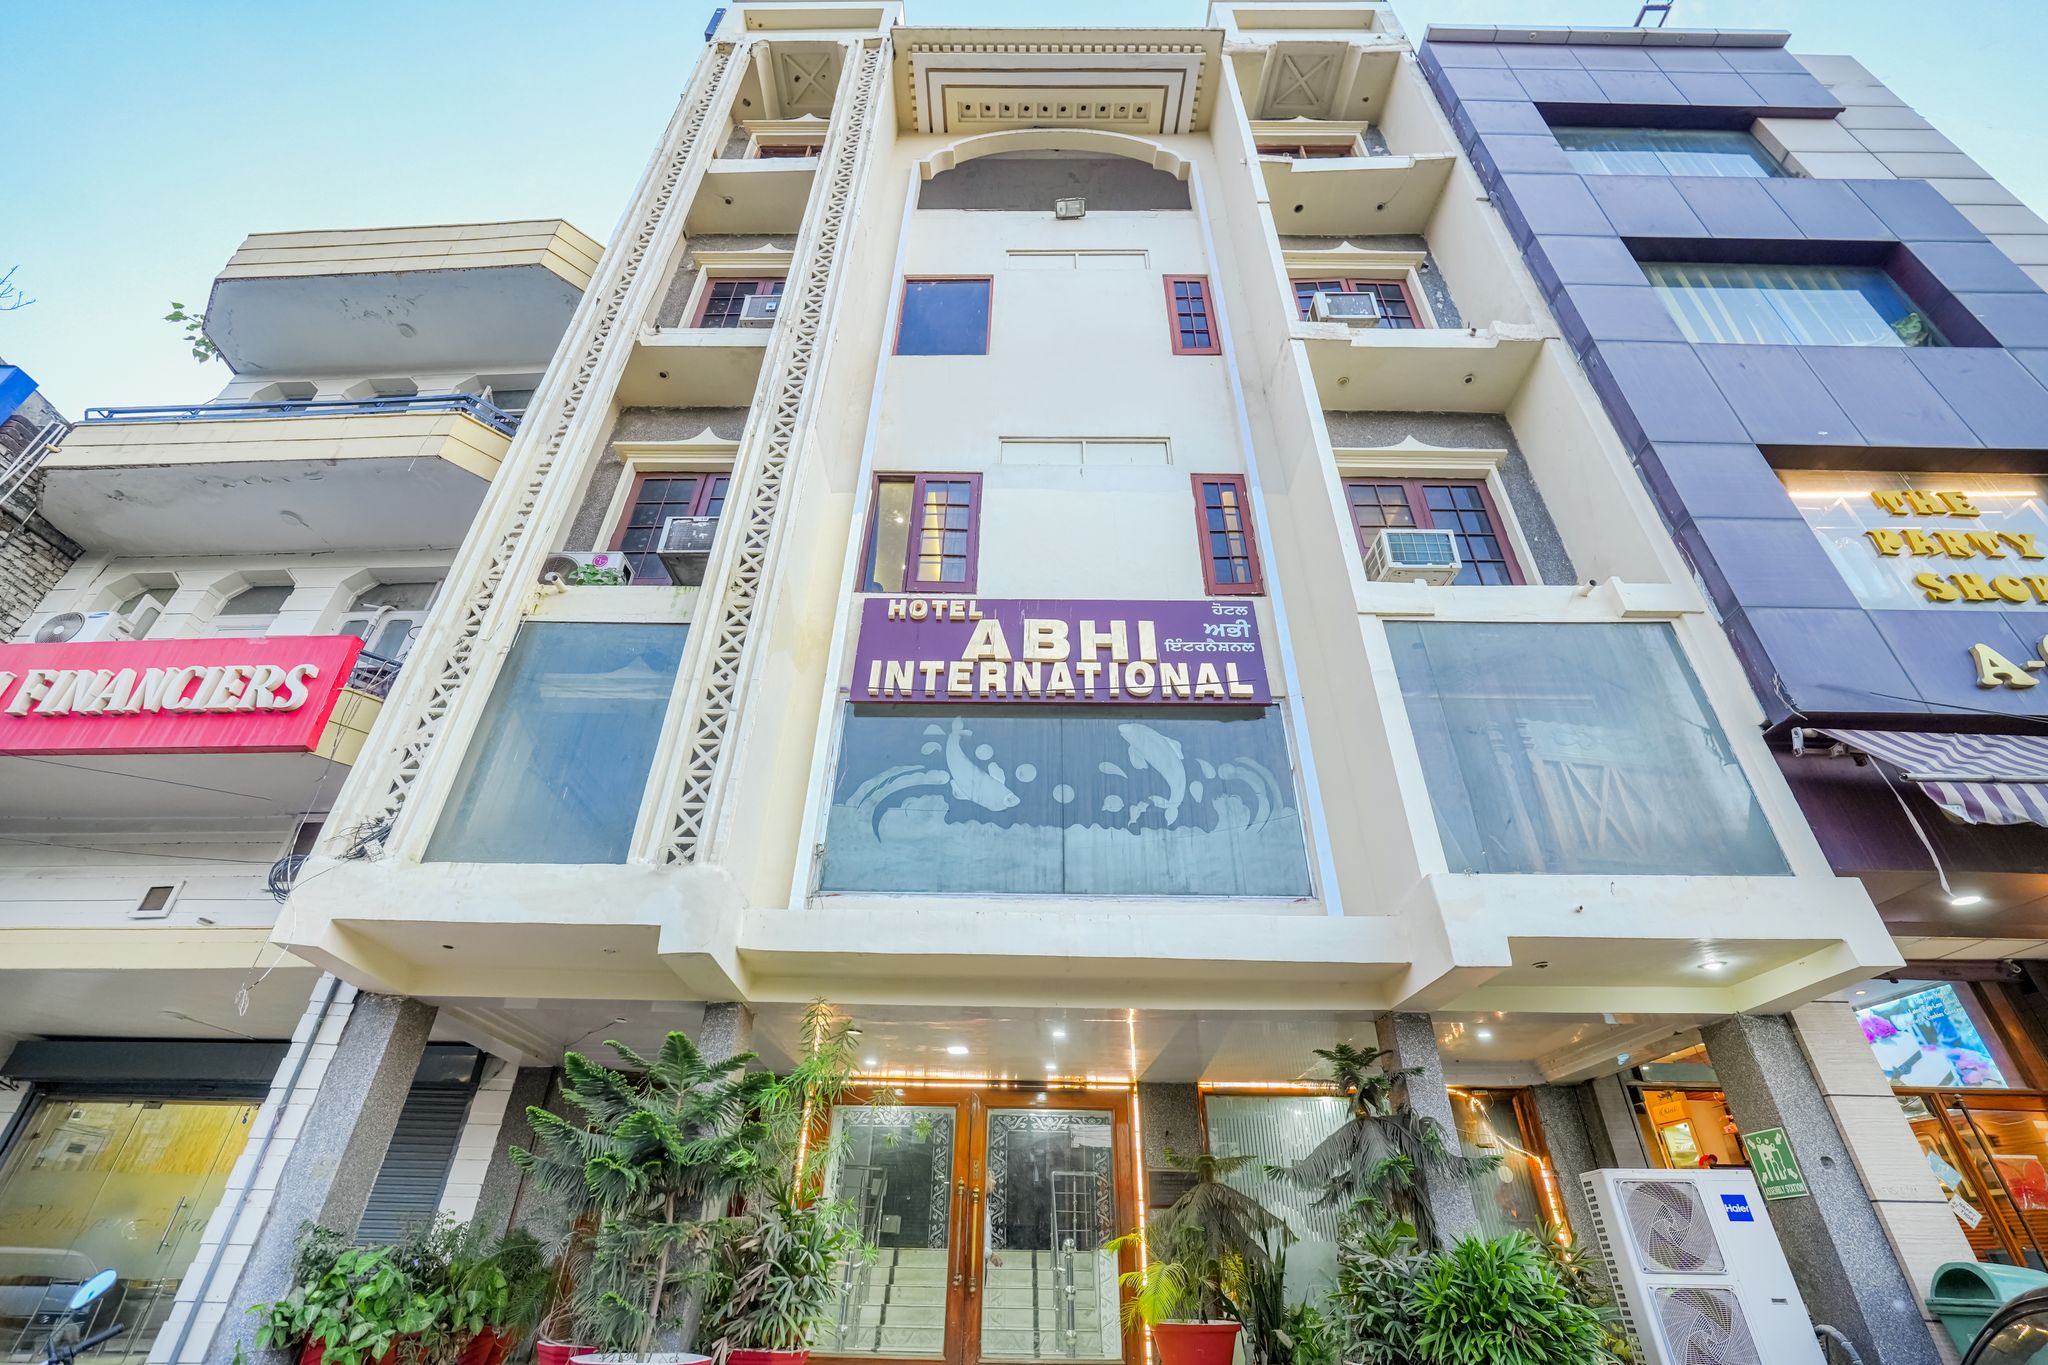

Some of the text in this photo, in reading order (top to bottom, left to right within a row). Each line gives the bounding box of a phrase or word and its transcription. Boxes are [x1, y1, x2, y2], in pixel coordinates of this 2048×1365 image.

[1871, 490, 1981, 517] THE
[1863, 528, 2046, 560] PARTY
[888, 599, 983, 620] HOTEL
[1211, 602, 1248, 616] ਹੋਟਲ
[961, 618, 1160, 664] ABHI
[1203, 619, 1251, 637] ਅਭੀ
[1968, 633, 2048, 690] A-
[3, 663, 321, 718] FINANCIERS
[867, 659, 1256, 698] INTERNATIONAL
[1785, 1182, 1806, 1193] STATION
[1724, 1203, 1750, 1213] Haier
